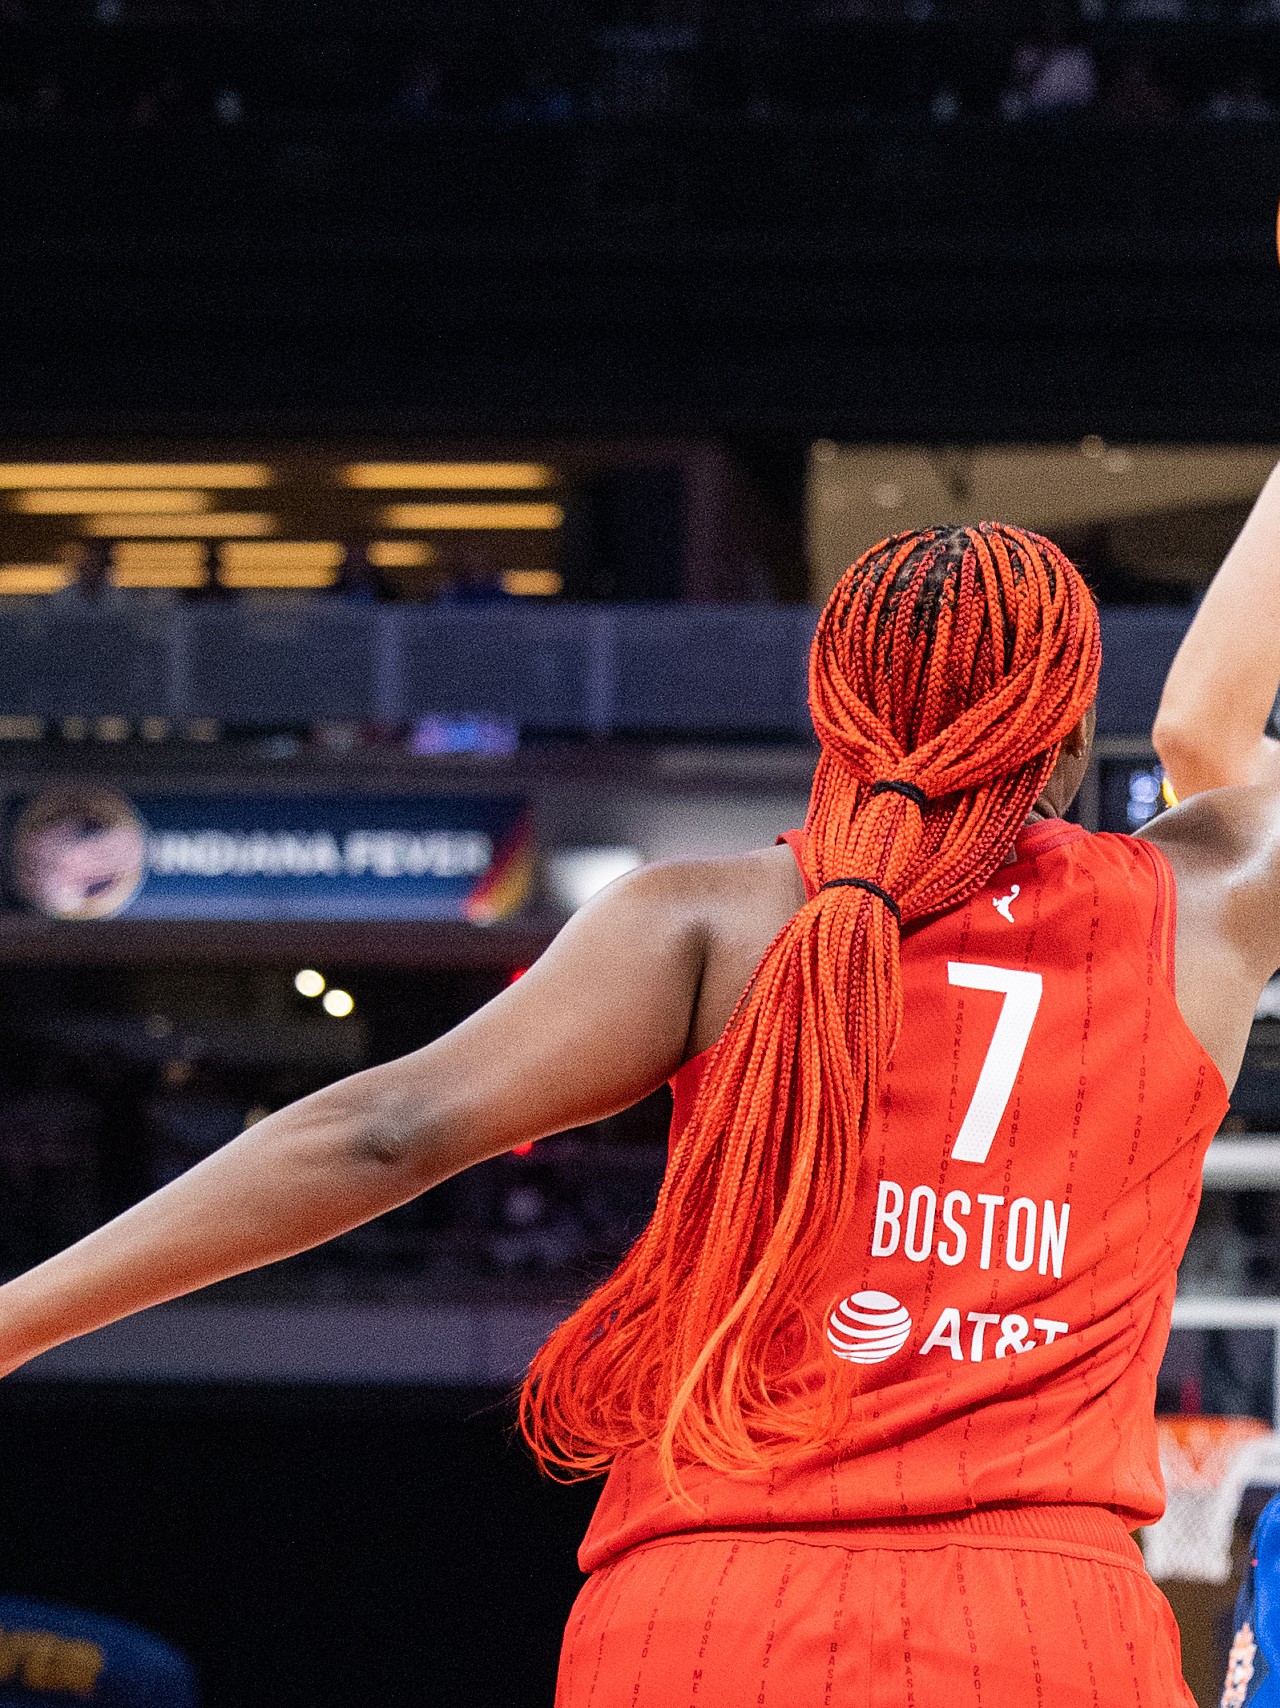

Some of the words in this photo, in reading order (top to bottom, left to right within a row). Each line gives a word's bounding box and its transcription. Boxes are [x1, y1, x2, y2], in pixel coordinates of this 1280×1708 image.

[345, 830, 493, 877] FEVER
[947, 961, 1042, 1163] 7
[871, 1181, 1070, 1278] BOSTON
[919, 1308, 1068, 1361] AT&T
